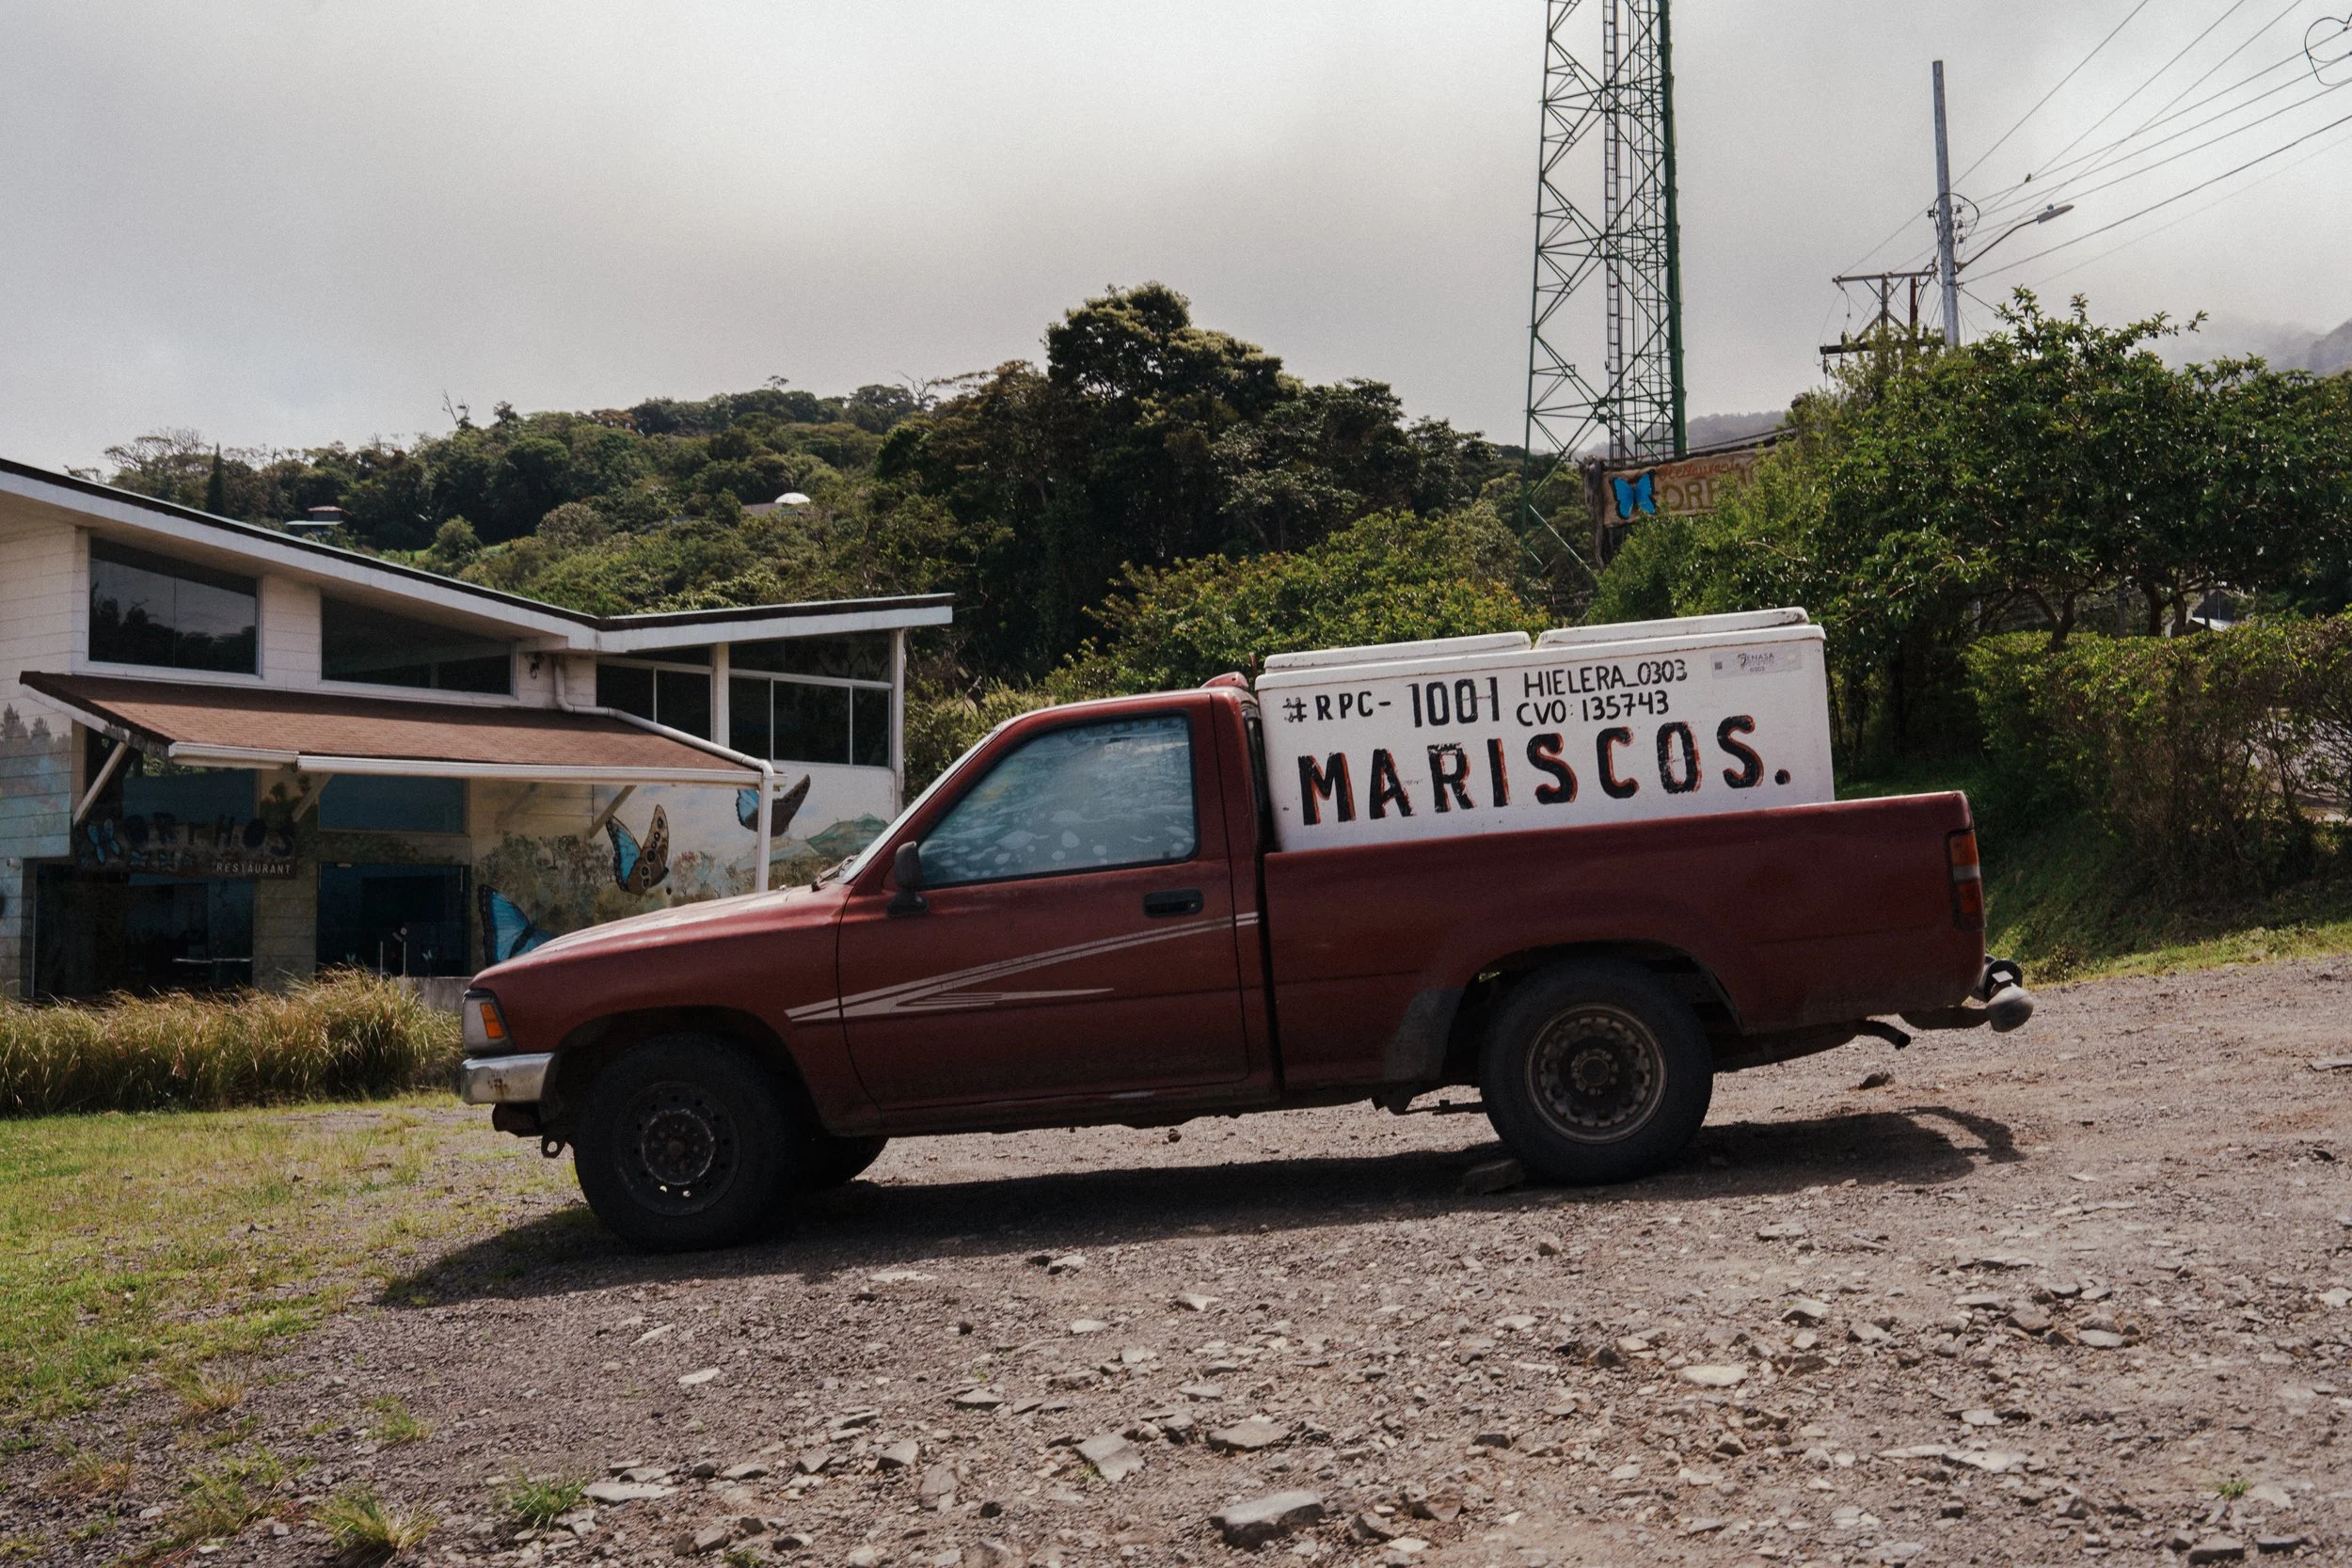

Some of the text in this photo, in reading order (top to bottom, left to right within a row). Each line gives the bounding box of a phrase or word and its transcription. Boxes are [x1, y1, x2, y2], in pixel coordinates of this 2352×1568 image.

[1406, 676, 1500, 728] 1001
[1582, 689, 1669, 721] 135743
[1297, 714, 1791, 826] MARISCOS.
[215, 863, 291, 874] RESTAURANT
